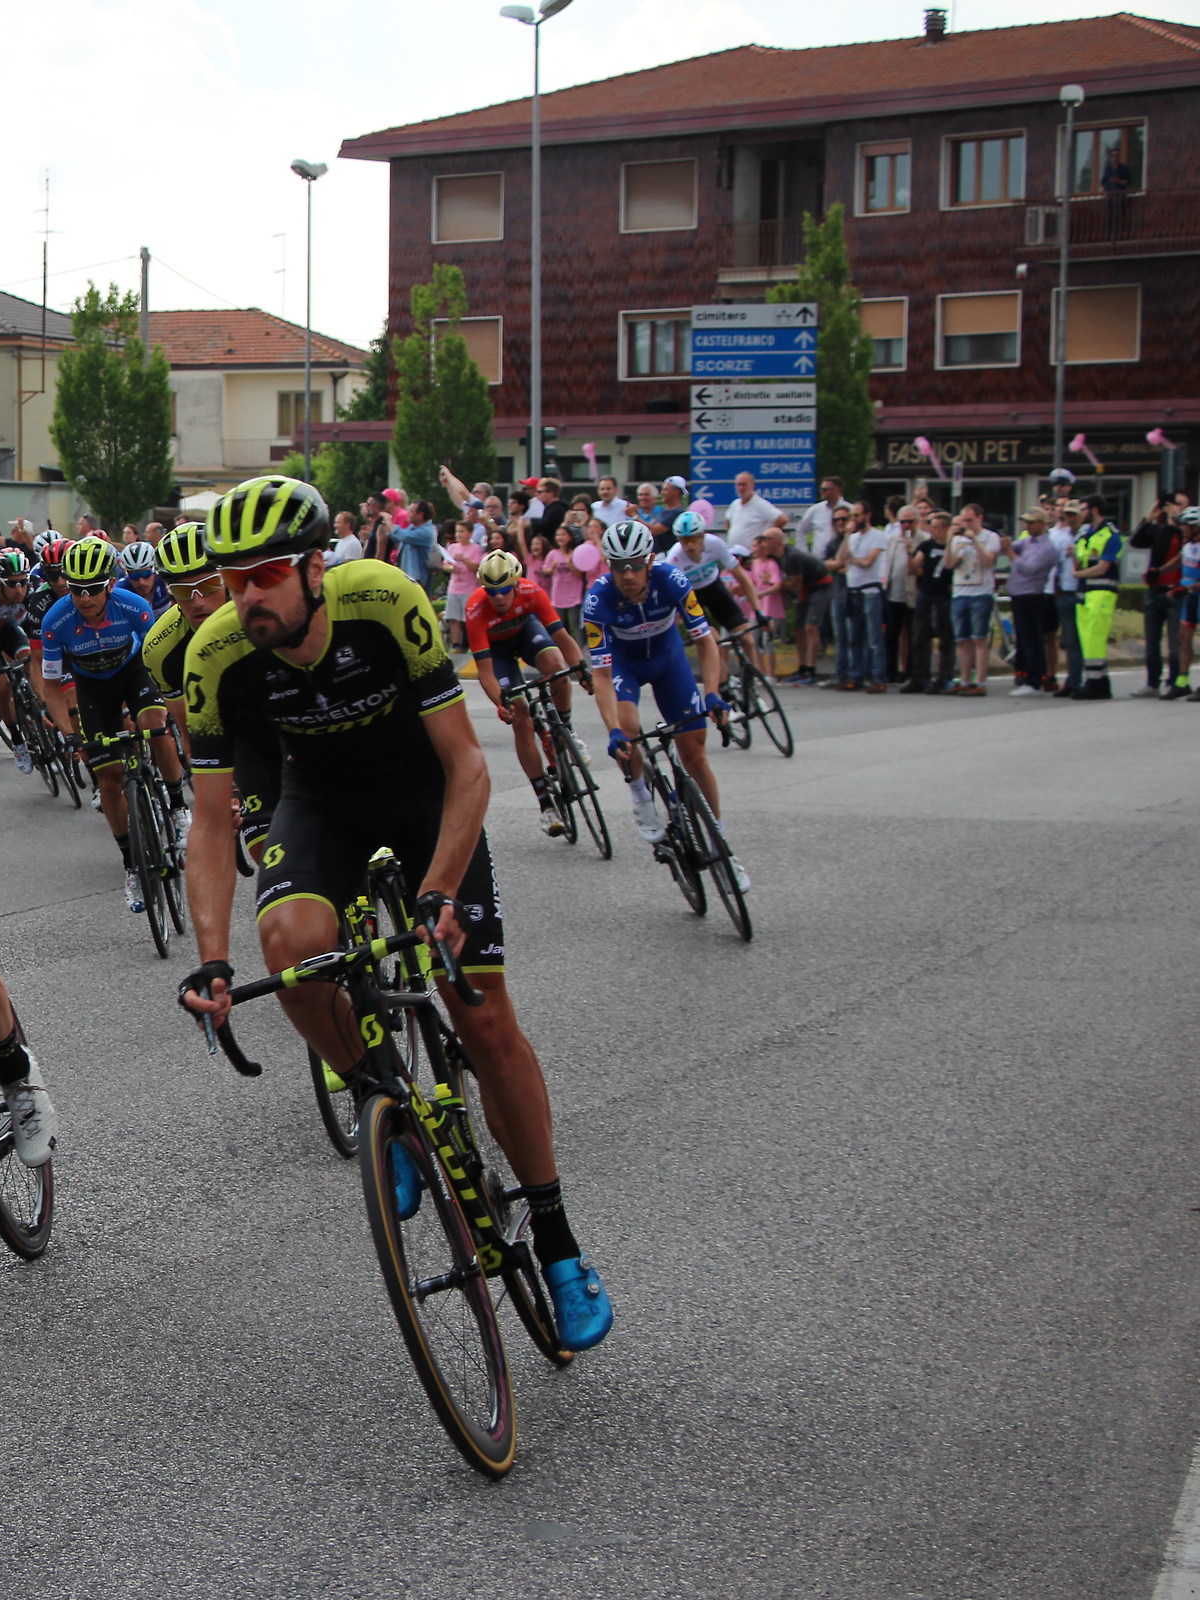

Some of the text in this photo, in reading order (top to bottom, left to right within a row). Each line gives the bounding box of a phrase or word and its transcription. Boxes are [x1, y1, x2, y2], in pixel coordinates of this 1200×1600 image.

[696, 311, 748, 322] cimitero
[695, 335, 775, 347] CASTELFRANCO
[774, 414, 812, 424] stadio
[715, 438, 812, 450] PORTO MARGHERA
[984, 440, 1021, 462] PET
[760, 463, 812, 474] SPINEA
